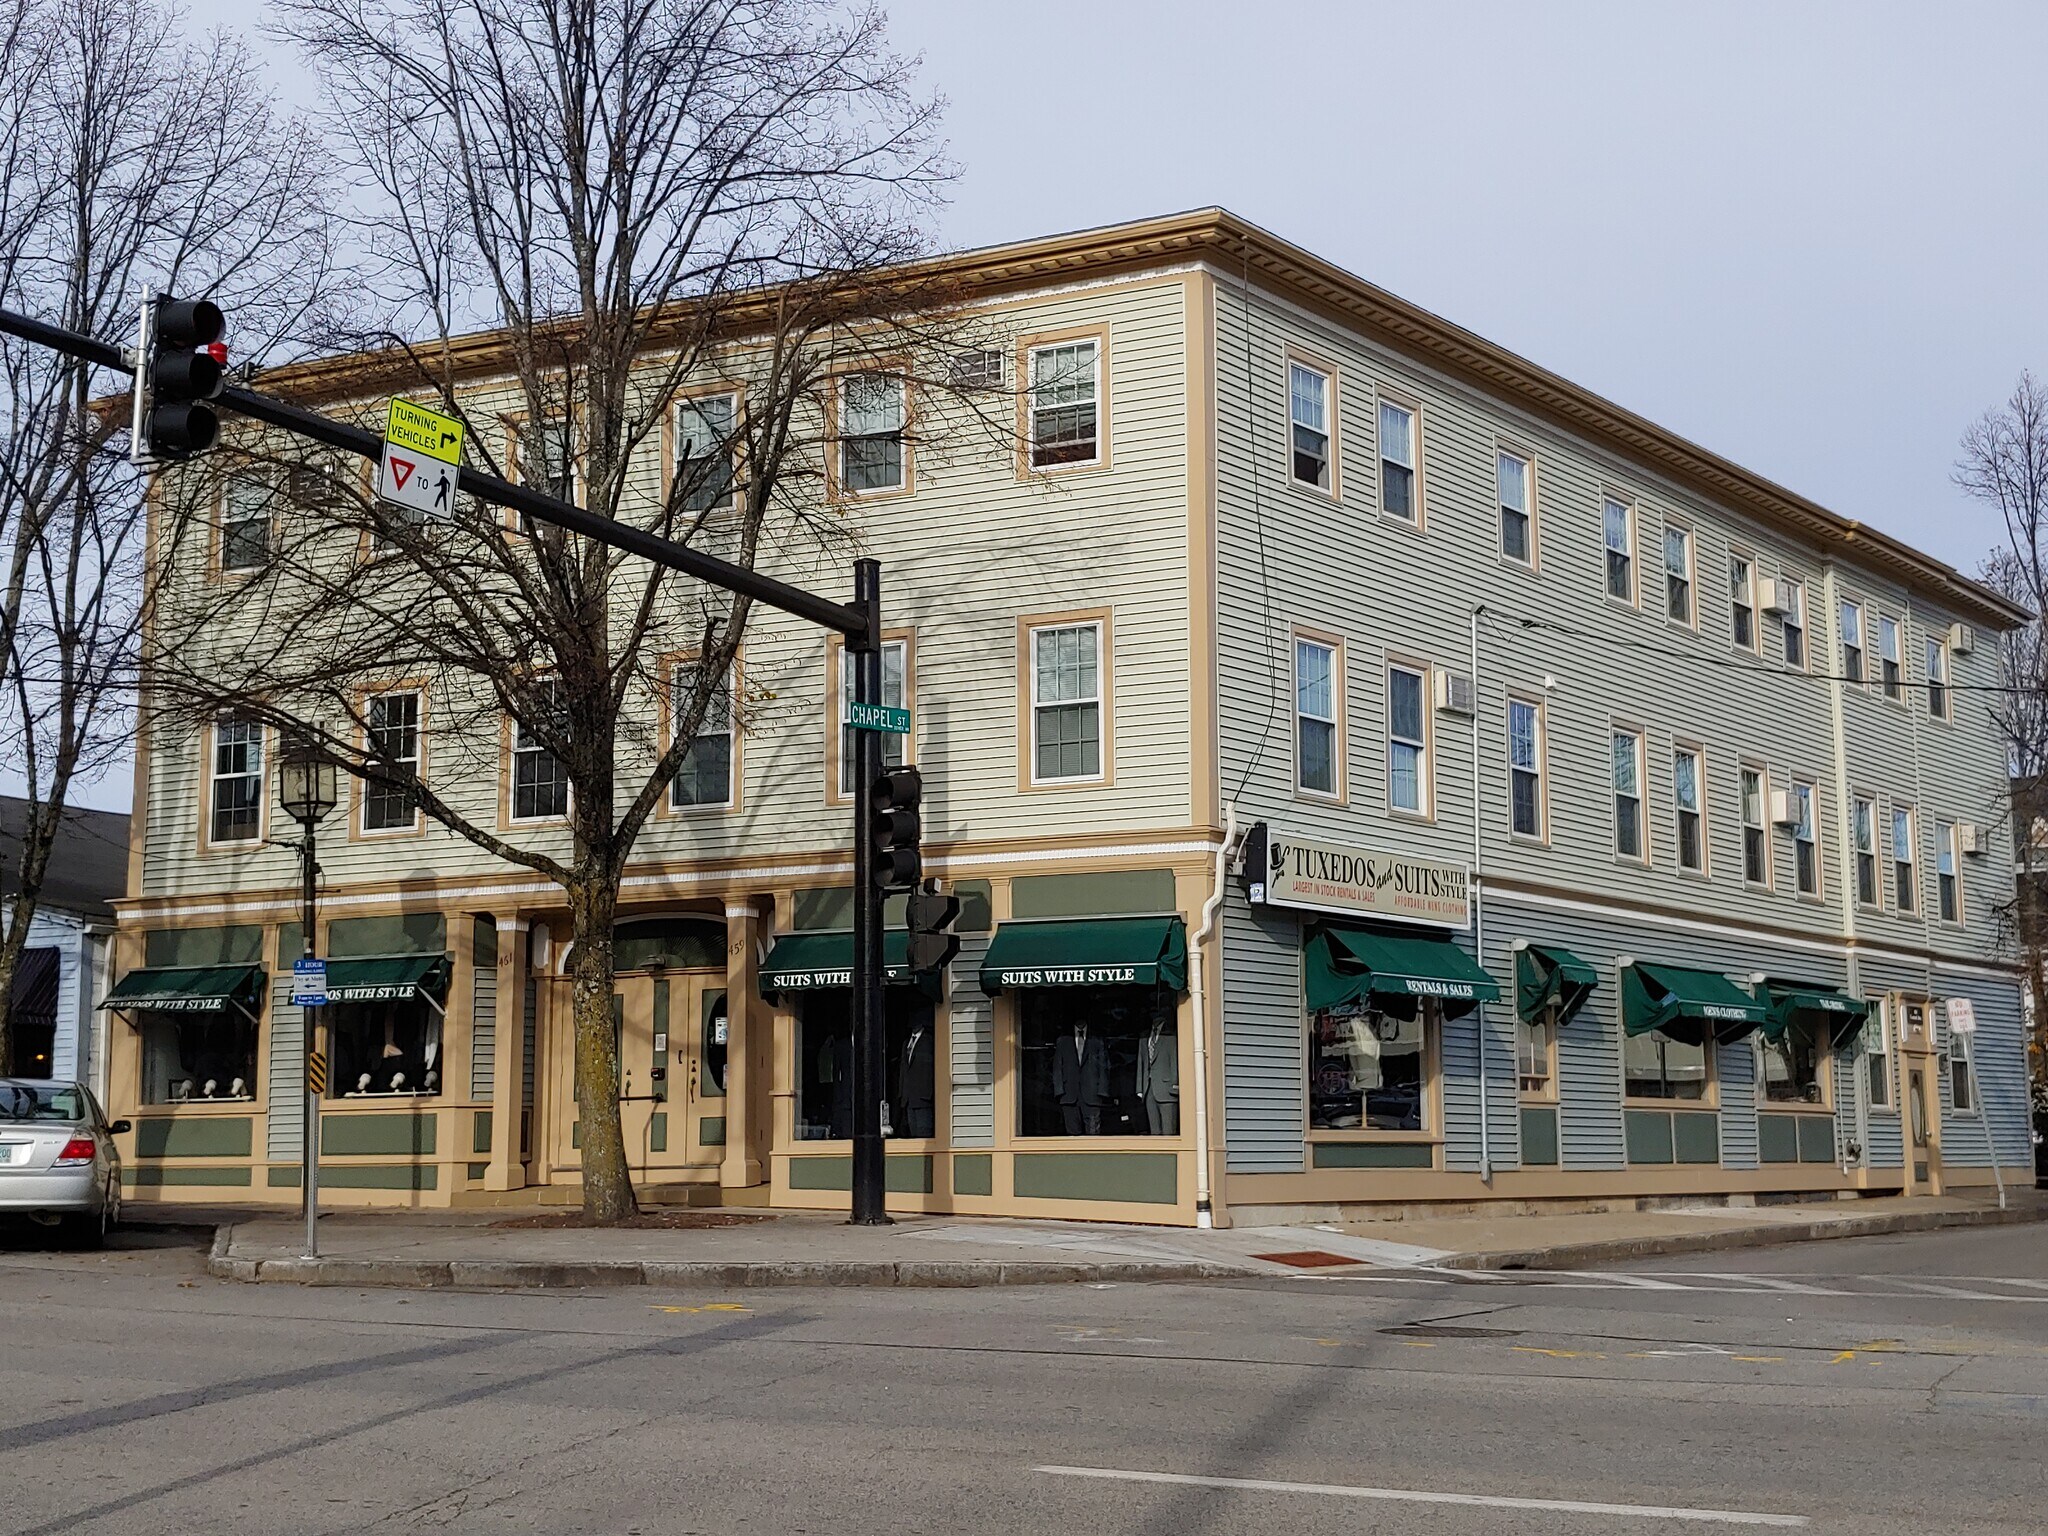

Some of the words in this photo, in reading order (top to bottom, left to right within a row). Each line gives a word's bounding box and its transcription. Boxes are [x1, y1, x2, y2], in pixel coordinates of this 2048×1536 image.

[395, 406, 437, 432] TURNING
[392, 424, 436, 450] VEHICLES
[417, 476, 429, 490] TO
[852, 705, 893, 728] CHAPEL
[897, 716, 905, 726] ST
[1293, 847, 1376, 888] TUXEDOS
[1376, 860, 1393, 890] and
[1394, 863, 1440, 897] SUITS
[1442, 869, 1465, 885] WITH
[1293, 881, 1313, 894] LARGEST
[1314, 884, 1320, 895] IN
[1321, 884, 1336, 898] STOCK
[1337, 887, 1356, 900] RENTALS
[1362, 890, 1375, 903] SALES
[1440, 884, 1467, 900] STYLE
[1394, 895, 1425, 911] AFFORDABLE
[729, 939, 744, 956] 459
[499, 952, 512, 967] 461
[773, 974, 811, 987] SUITS
[814, 971, 851, 985] WITH
[1001, 971, 1041, 984] SUITS
[1044, 969, 1084, 983] WITH
[1087, 968, 1135, 982] STYLE
[344, 988, 375, 1000] WITH
[376, 986, 415, 999] STYLE
[1406, 980, 1441, 994] RENTALS
[1442, 983, 1448, 995] &
[1449, 984, 1473, 997] SALES
[155, 1000, 185, 1010] WITH
[186, 999, 222, 1010] STYLE
